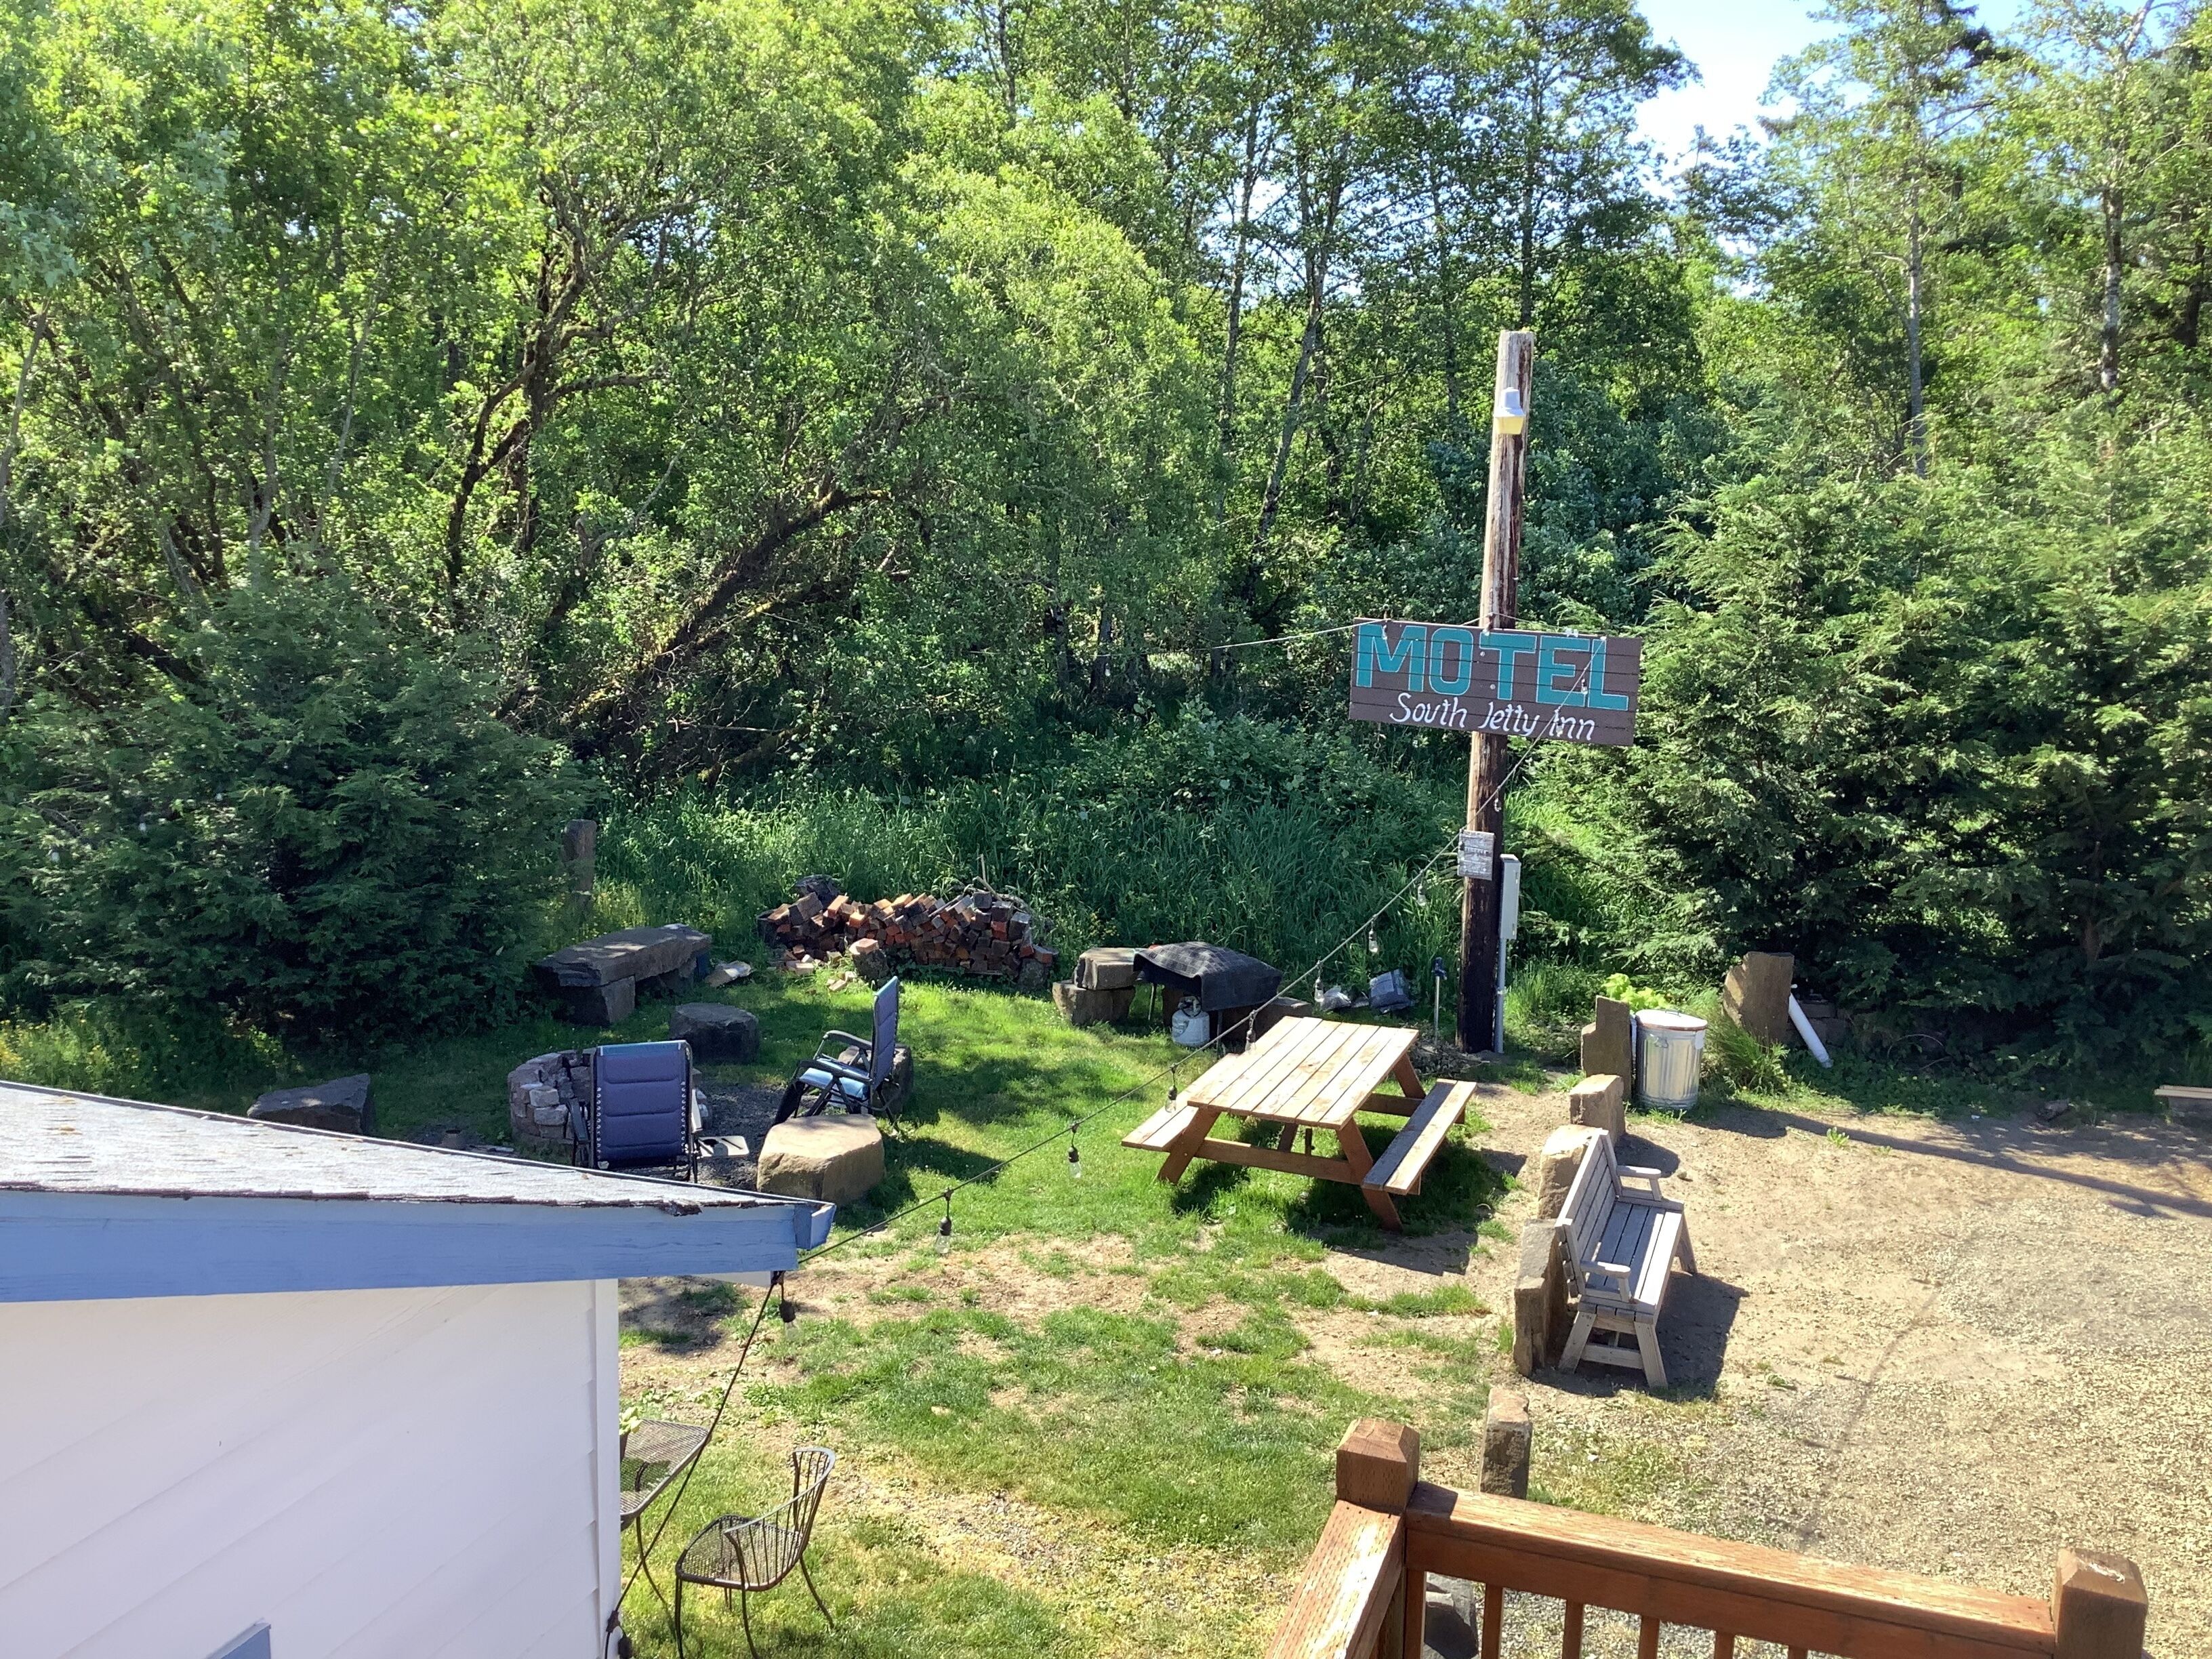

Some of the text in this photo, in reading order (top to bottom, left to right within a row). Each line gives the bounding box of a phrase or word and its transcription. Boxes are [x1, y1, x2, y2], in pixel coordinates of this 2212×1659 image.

[1355, 623, 1629, 711] MOTEL
[1389, 692, 1595, 741] South Jetty Inn
